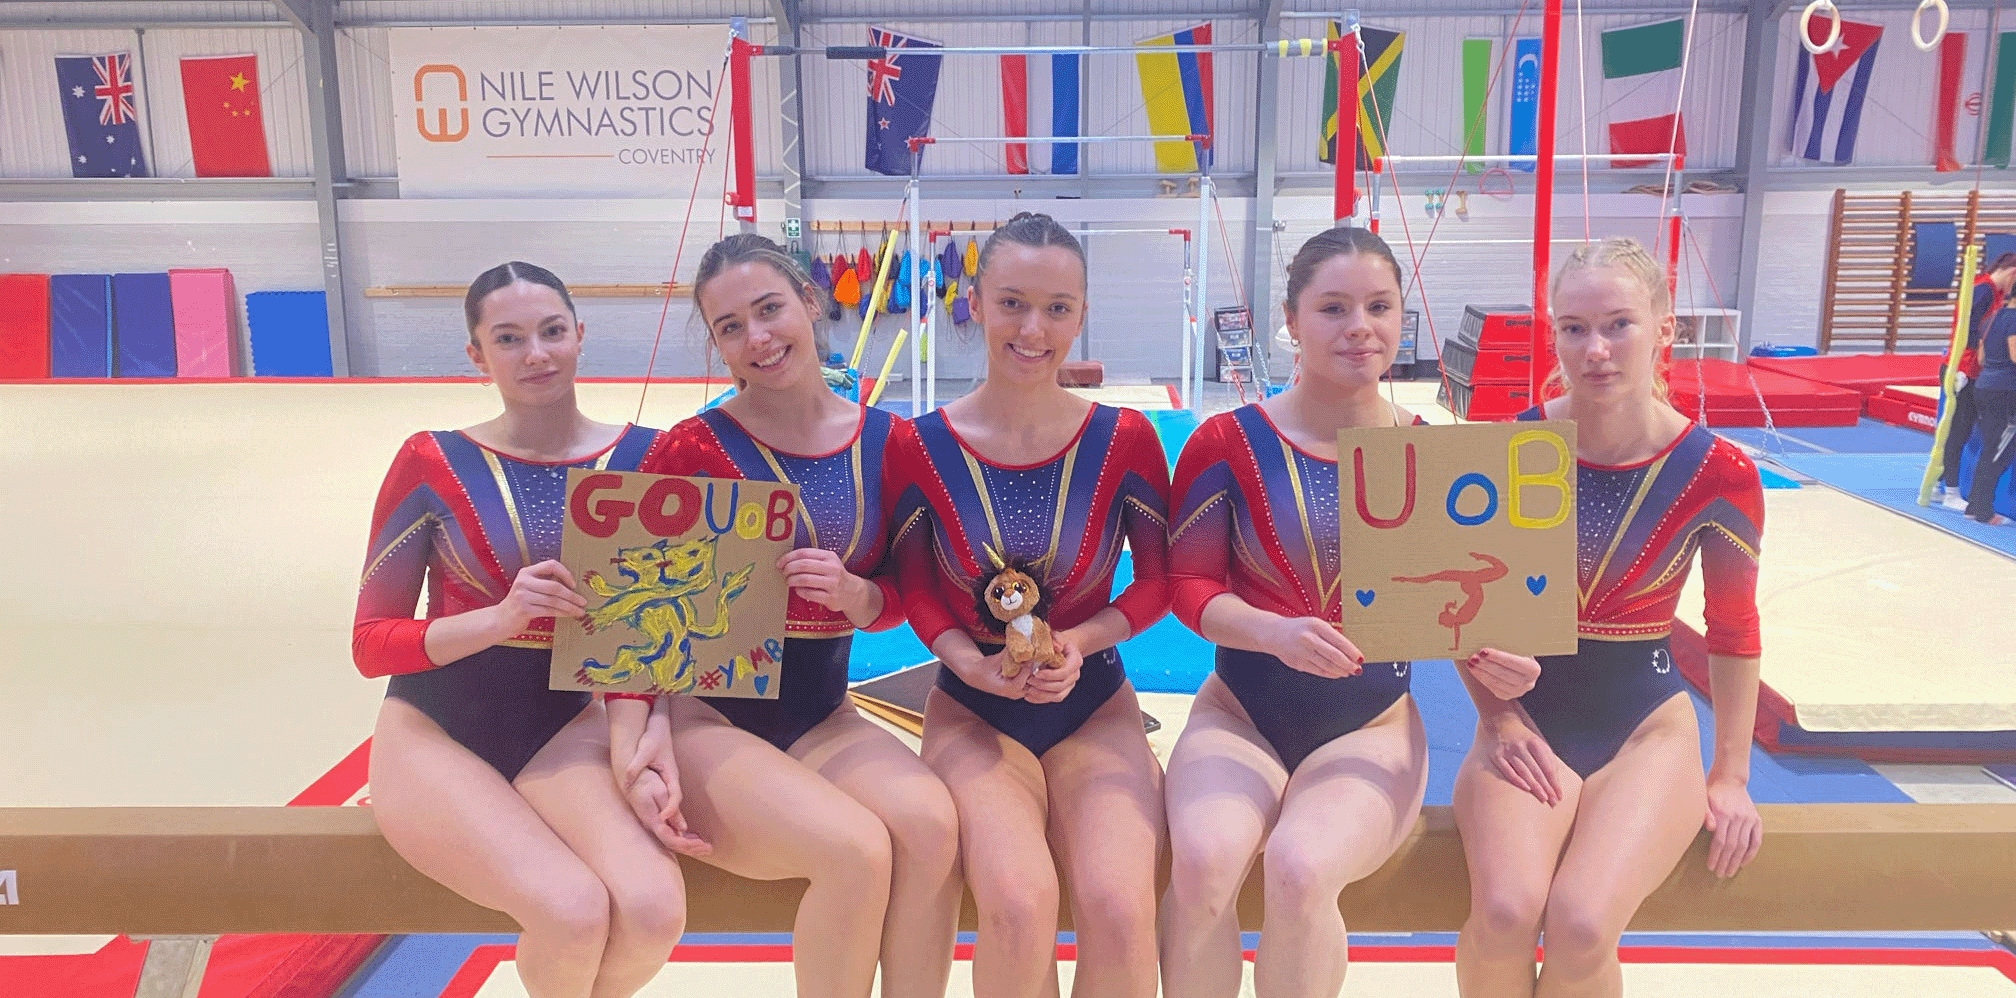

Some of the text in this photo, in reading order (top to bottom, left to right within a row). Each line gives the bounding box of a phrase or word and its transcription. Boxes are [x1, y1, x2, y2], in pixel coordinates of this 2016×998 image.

[480, 69, 712, 102] NILE WILSON
[482, 105, 715, 138] GYMNASTICS
[618, 148, 716, 164] COVENTRY
[570, 473, 702, 538] GO
[698, 638, 783, 690] #YAMB
